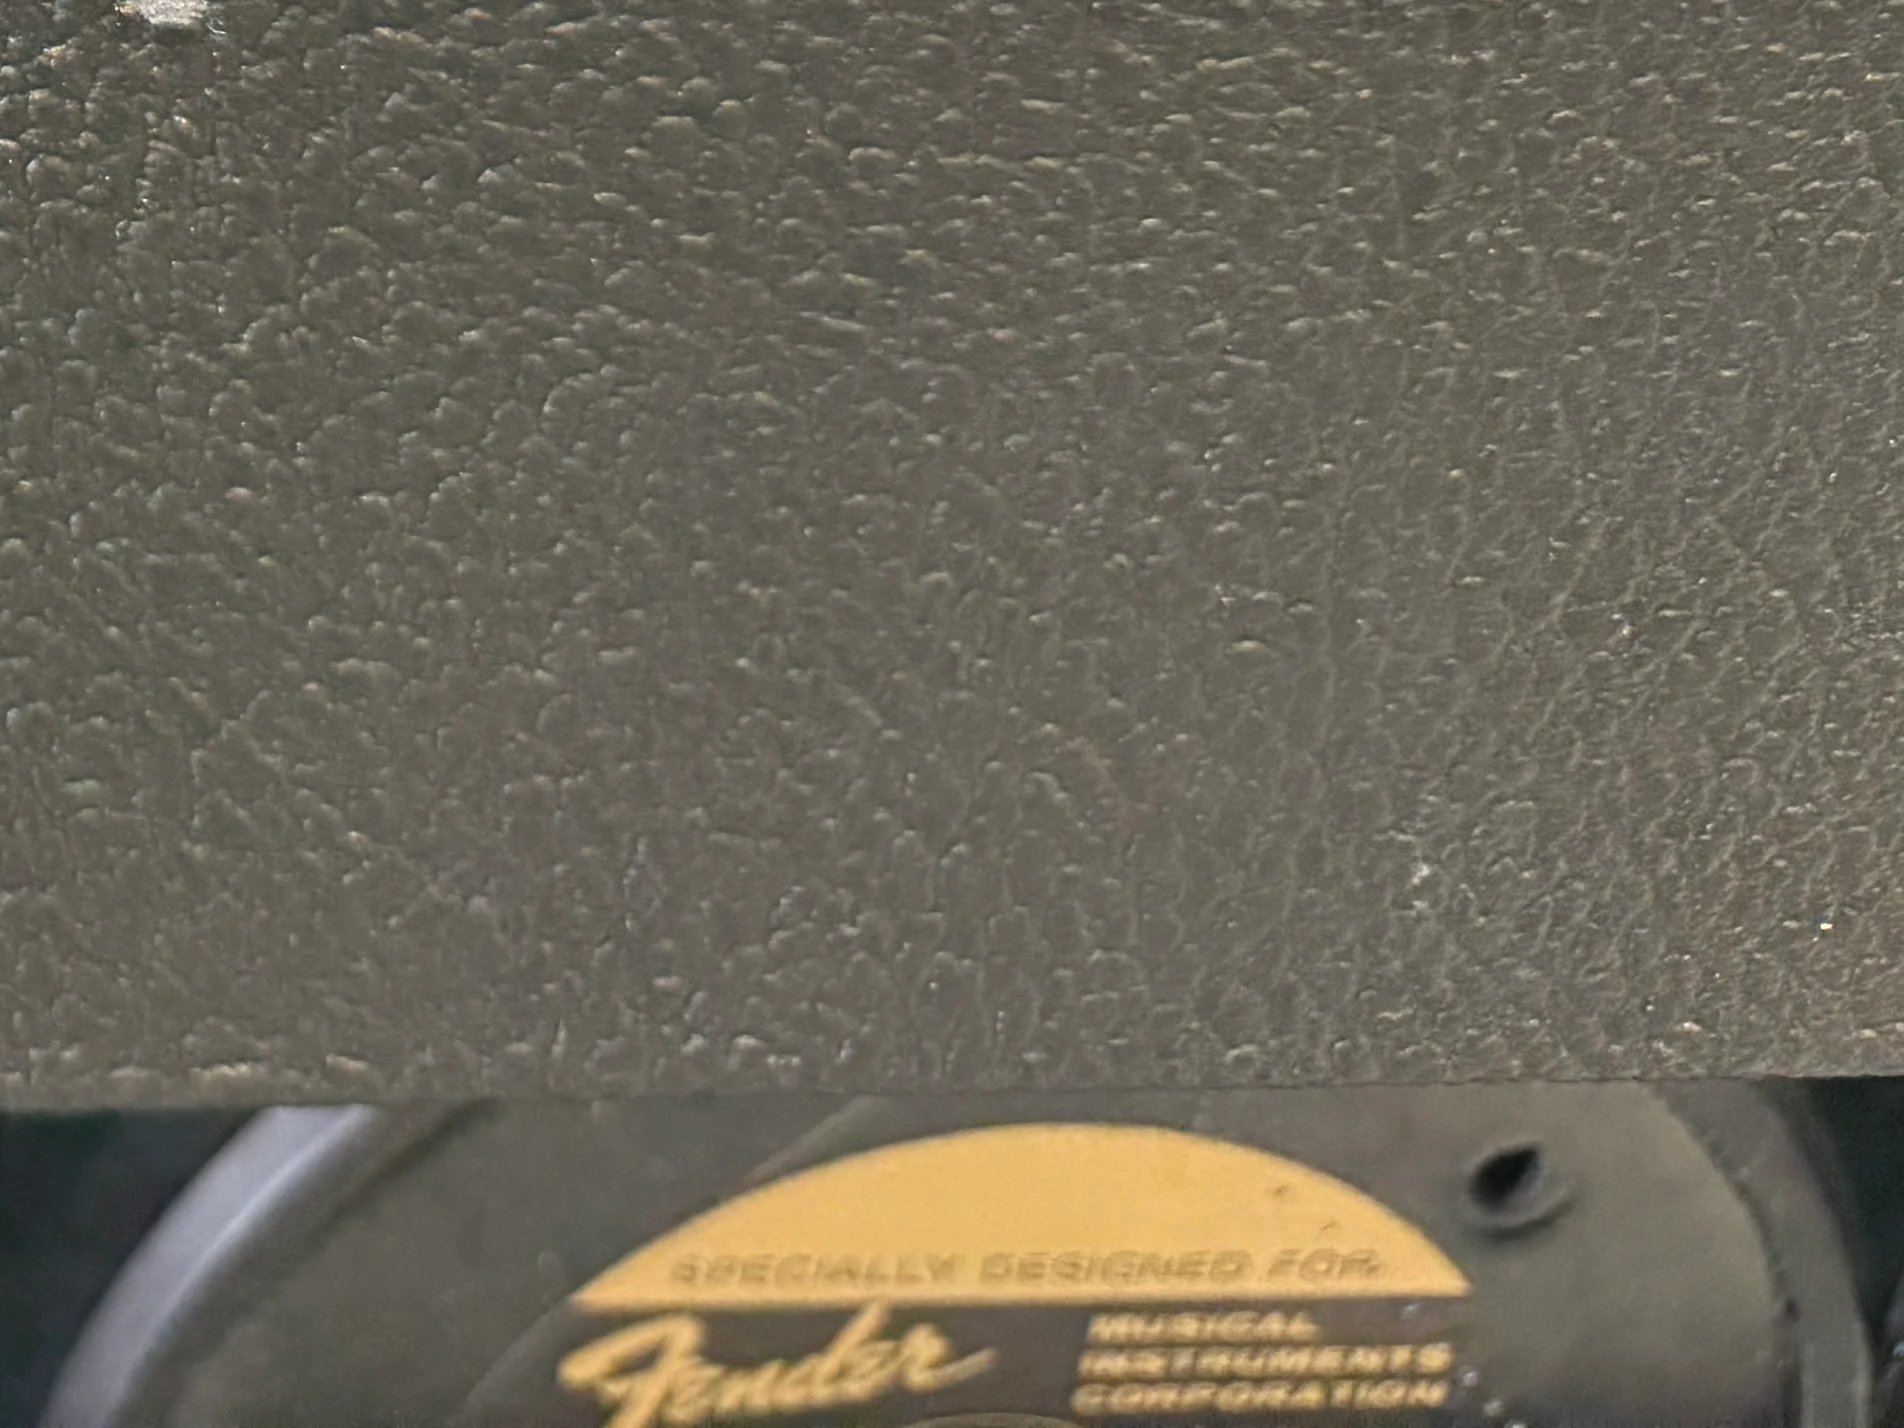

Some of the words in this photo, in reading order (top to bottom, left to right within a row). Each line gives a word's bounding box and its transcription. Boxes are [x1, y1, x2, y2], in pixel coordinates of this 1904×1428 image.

[669, 1250, 964, 1287] SPECIALLY
[978, 1249, 1254, 1286] DESIGNED
[1086, 1311, 1320, 1344] MUSICAL
[557, 1297, 997, 1428] Fender
[1078, 1342, 1453, 1380] INSTRUMENTS
[1069, 1378, 1450, 1416] CORPORATION
